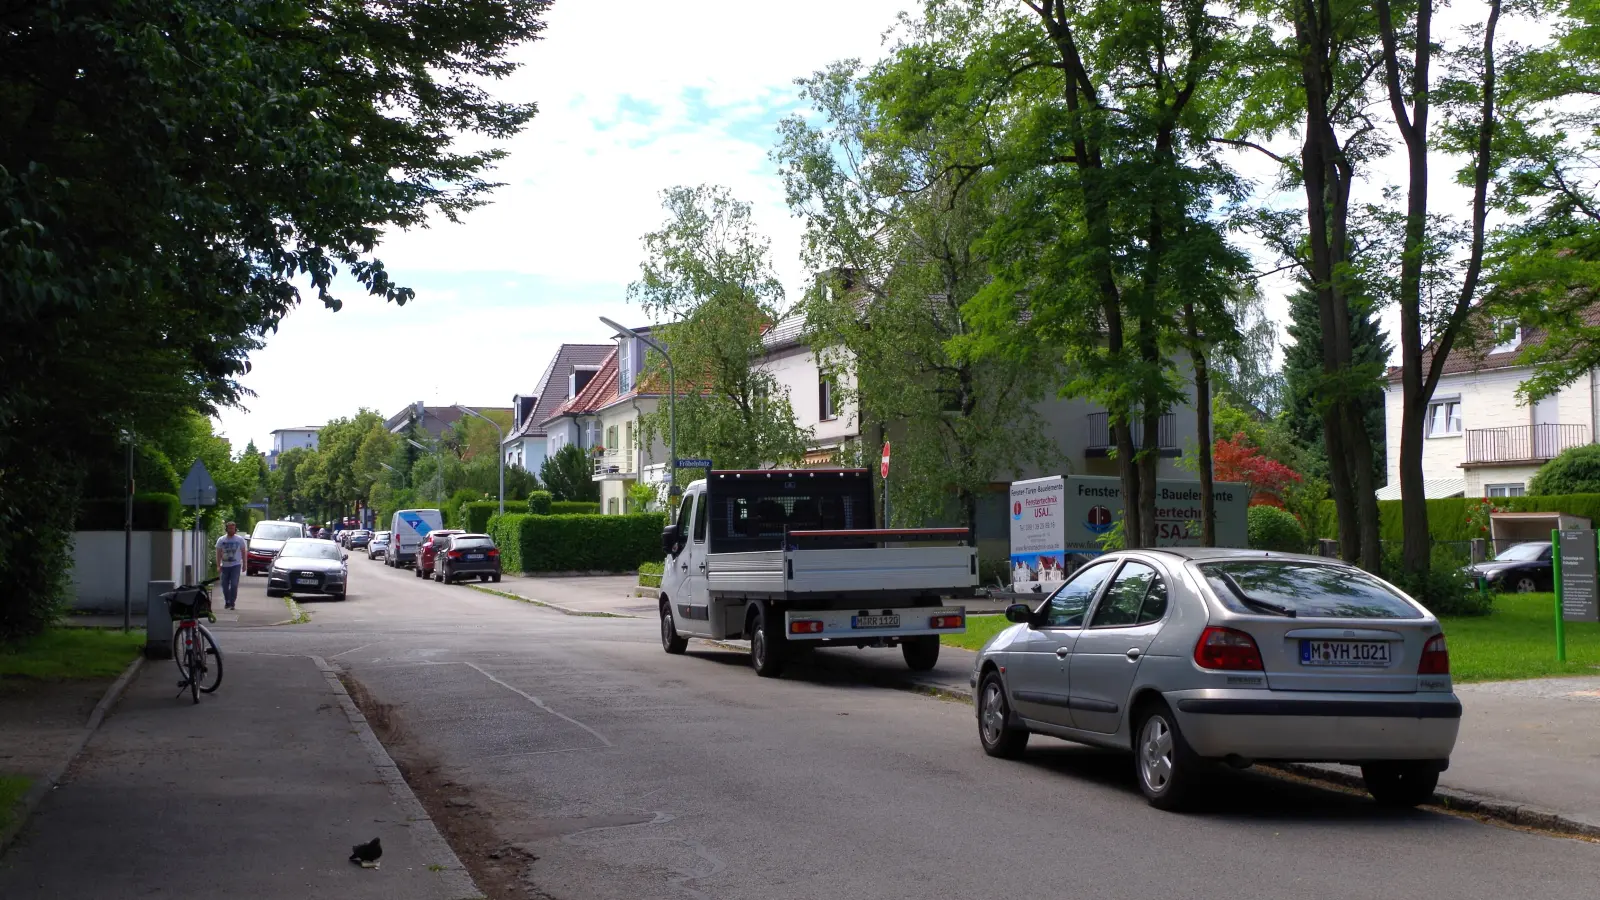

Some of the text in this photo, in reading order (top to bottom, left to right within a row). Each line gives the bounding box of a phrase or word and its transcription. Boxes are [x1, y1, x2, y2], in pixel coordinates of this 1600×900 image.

[1025, 495, 1057, 506] Fenstertechnik
[1034, 507, 1049, 518] USAJ
[879, 616, 899, 625] 1120
[1311, 643, 1387, 660] M YH 1021
